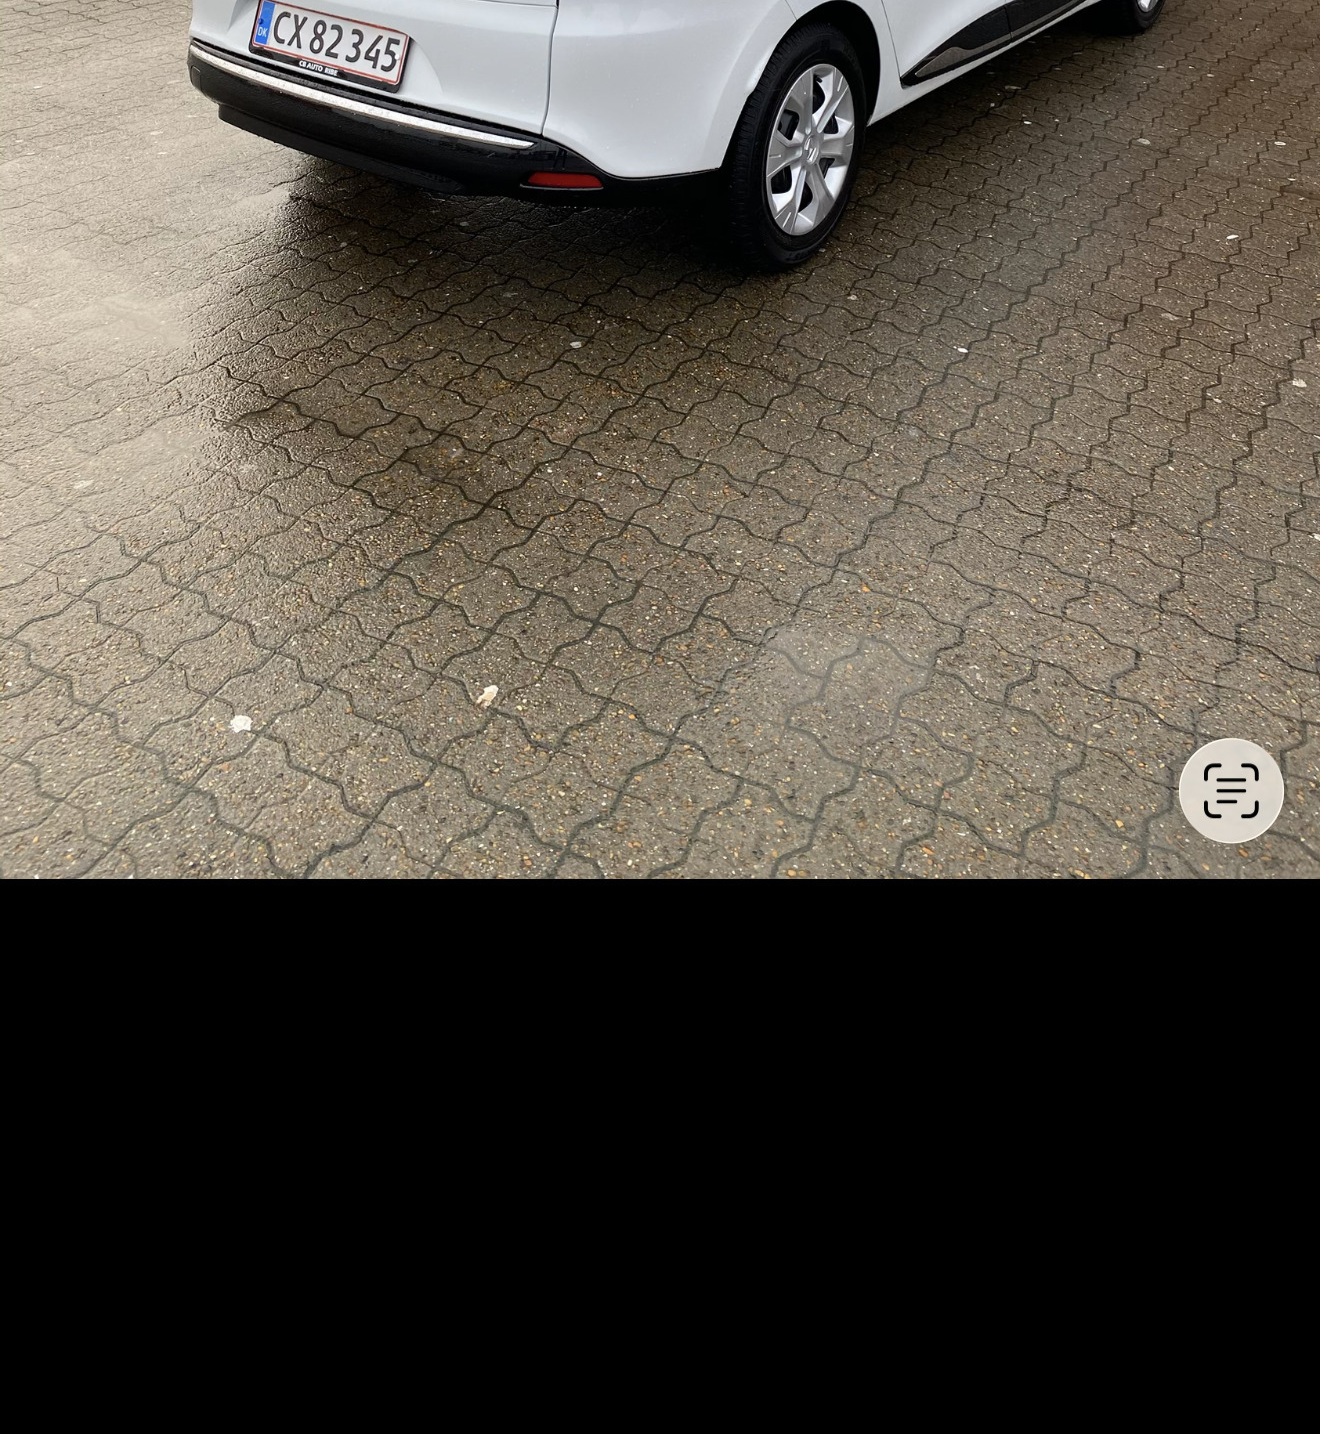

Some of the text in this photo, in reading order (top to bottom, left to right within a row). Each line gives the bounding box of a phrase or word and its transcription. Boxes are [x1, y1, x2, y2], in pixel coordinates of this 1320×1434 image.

[258, 26, 268, 38] DK
[273, 11, 400, 73] CX 82 345
[307, 62, 323, 72] AUTO
